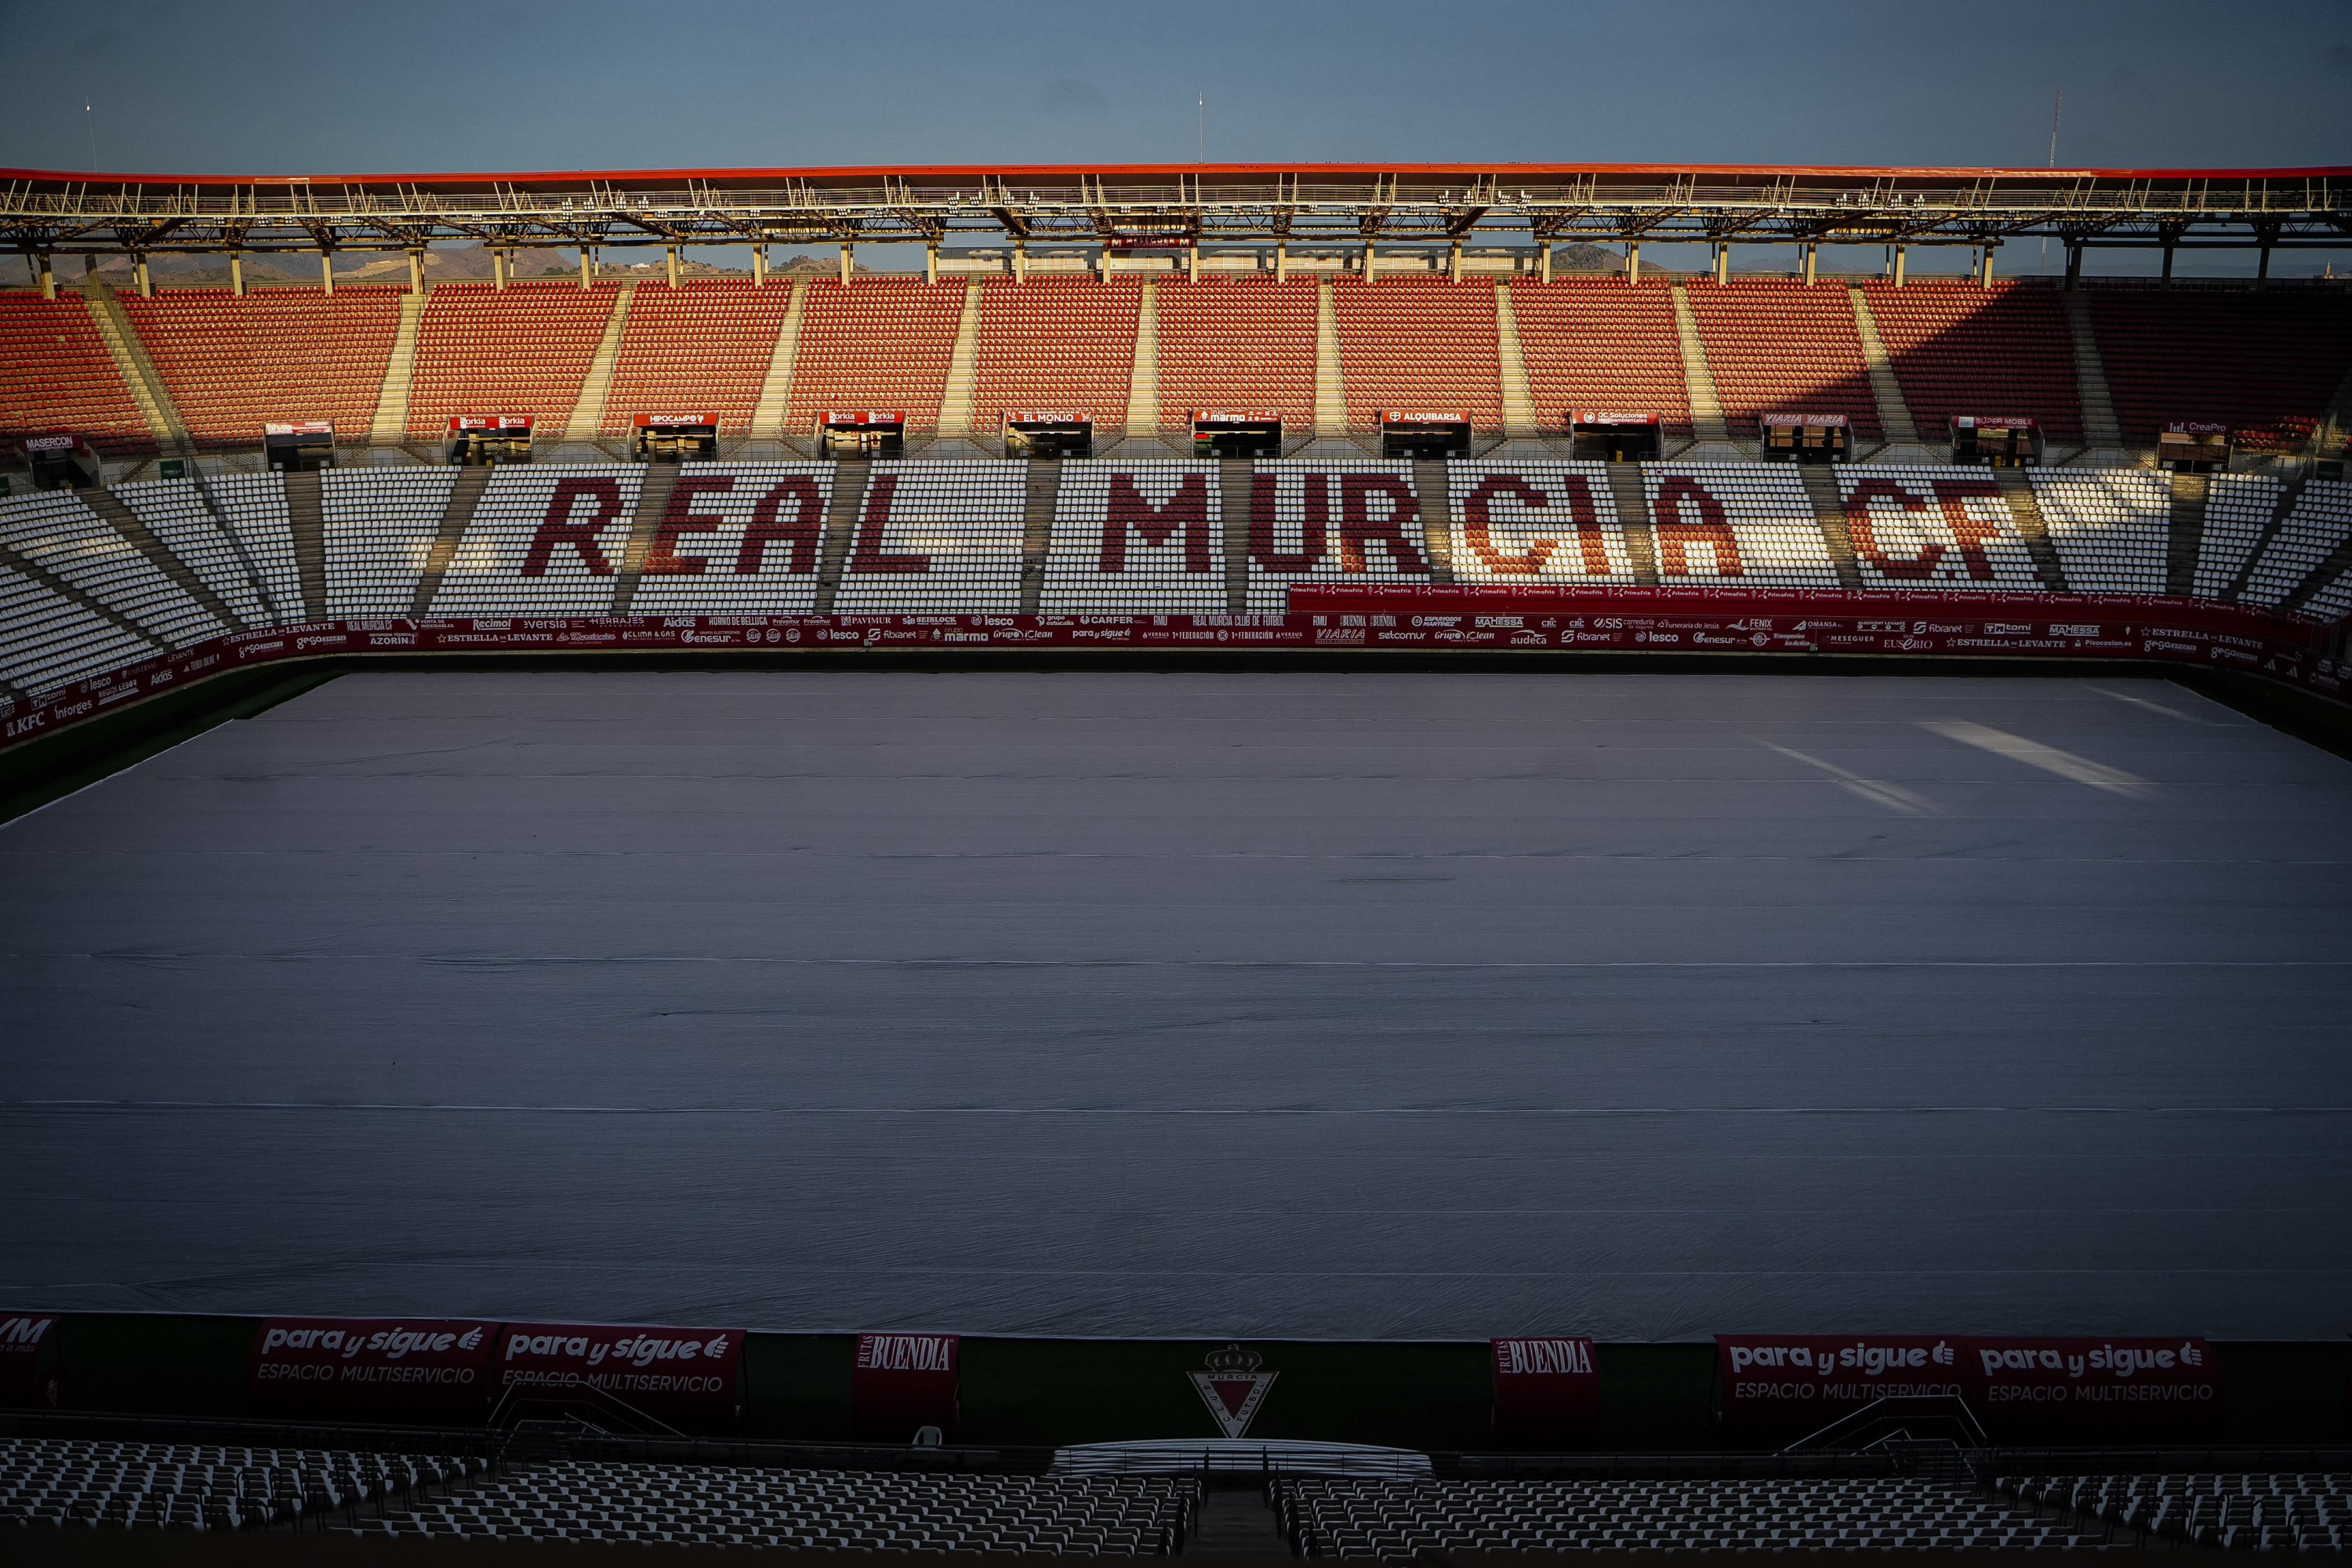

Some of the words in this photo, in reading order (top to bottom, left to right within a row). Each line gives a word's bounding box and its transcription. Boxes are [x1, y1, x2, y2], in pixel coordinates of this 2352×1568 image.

[499, 416, 525, 425] Sorkia
[1403, 412, 1461, 421] ALQUIBARSA
[1766, 414, 1802, 423] VIARIA
[1807, 415, 1843, 423] VIARIA
[2189, 422, 2227, 432] CreaPro
[26, 436, 74, 448] MASERCON
[519, 475, 931, 576] REAL
[1098, 474, 1744, 576] MURCIA
[1843, 478, 2002, 579] CF
[347, 621, 361, 631] REAL
[361, 620, 384, 630] MURCIA
[473, 619, 511, 630] Recimol
[663, 617, 696, 627] Aidas
[709, 616, 731, 626] HORNO
[731, 616, 740, 626] DE
[985, 615, 1014, 626] lesco
[1192, 615, 1207, 626] REAL
[1209, 615, 1232, 626] MURCIA
[1235, 615, 1250, 626] CLUB
[1252, 615, 1260, 626] DE
[1475, 617, 1524, 627] MAHESSA
[1605, 618, 1623, 629] SIS
[230, 629, 277, 644] ESTRELLA
[286, 622, 335, 634] LEVANTE
[829, 629, 859, 640] lesco
[993, 630, 1020, 639] Grupo
[1025, 630, 1053, 638] iClean
[1073, 630, 1094, 639] para
[1100, 629, 1123, 639] sigue
[1179, 630, 1214, 640] FEDERACIÓN
[1238, 630, 1273, 640] FEDERACIÓN
[1316, 628, 1365, 639] VIARIA
[1378, 630, 1427, 640] setcomur
[1434, 631, 1461, 641] Grupo
[1466, 631, 1495, 640] iClean
[1577, 630, 1610, 641] fibranet
[1649, 630, 1679, 642] lesco
[2049, 625, 2100, 637] MAHESSA
[370, 636, 408, 645] AZORÍN
[447, 633, 499, 642] ESTRELLA
[944, 633, 989, 641] marmo
[2151, 628, 2209, 640] ESTRELLA
[2219, 634, 2263, 649] LEVANTE
[2018, 640, 2067, 648] LEVANTE
[167, 648, 194, 662] LEVANTE
[89, 676, 111, 691] lesco
[16, 711, 45, 734] KFC
[15, 1343, 35, 1352] más
[261, 1328, 346, 1354] para
[341, 1336, 366, 1359] y
[366, 1327, 456, 1359] sigue
[505, 1334, 589, 1361] para
[586, 1343, 611, 1366] y
[612, 1334, 702, 1367] sigue
[857, 1335, 874, 1369] FRUTAS
[869, 1336, 950, 1371] BUENDIA
[1496, 1341, 1512, 1374] FRUTAS
[1508, 1340, 1593, 1374] BUENDIA
[1730, 1346, 1813, 1374] para
[1817, 1353, 1835, 1376] y
[1839, 1342, 1929, 1376] sigue
[1979, 1348, 2063, 1377] para
[2068, 1355, 2085, 1378] y
[2089, 1344, 2176, 1377] sigue
[257, 1363, 334, 1381] ESPACIO
[340, 1365, 475, 1384] MULTISERVICIO
[502, 1370, 579, 1388] ESPACIO
[587, 1373, 723, 1392] MULTISERVICIO
[1735, 1382, 1815, 1399] ESPACIO
[1823, 1383, 1962, 1400] MULTISERVICIO
[1988, 1385, 2067, 1402] ESPACIO
[2074, 1385, 2213, 1402] MULTISERVICIO
[1203, 1384, 1231, 1422] CLUB
[1236, 1383, 1264, 1422] FUTBOL
